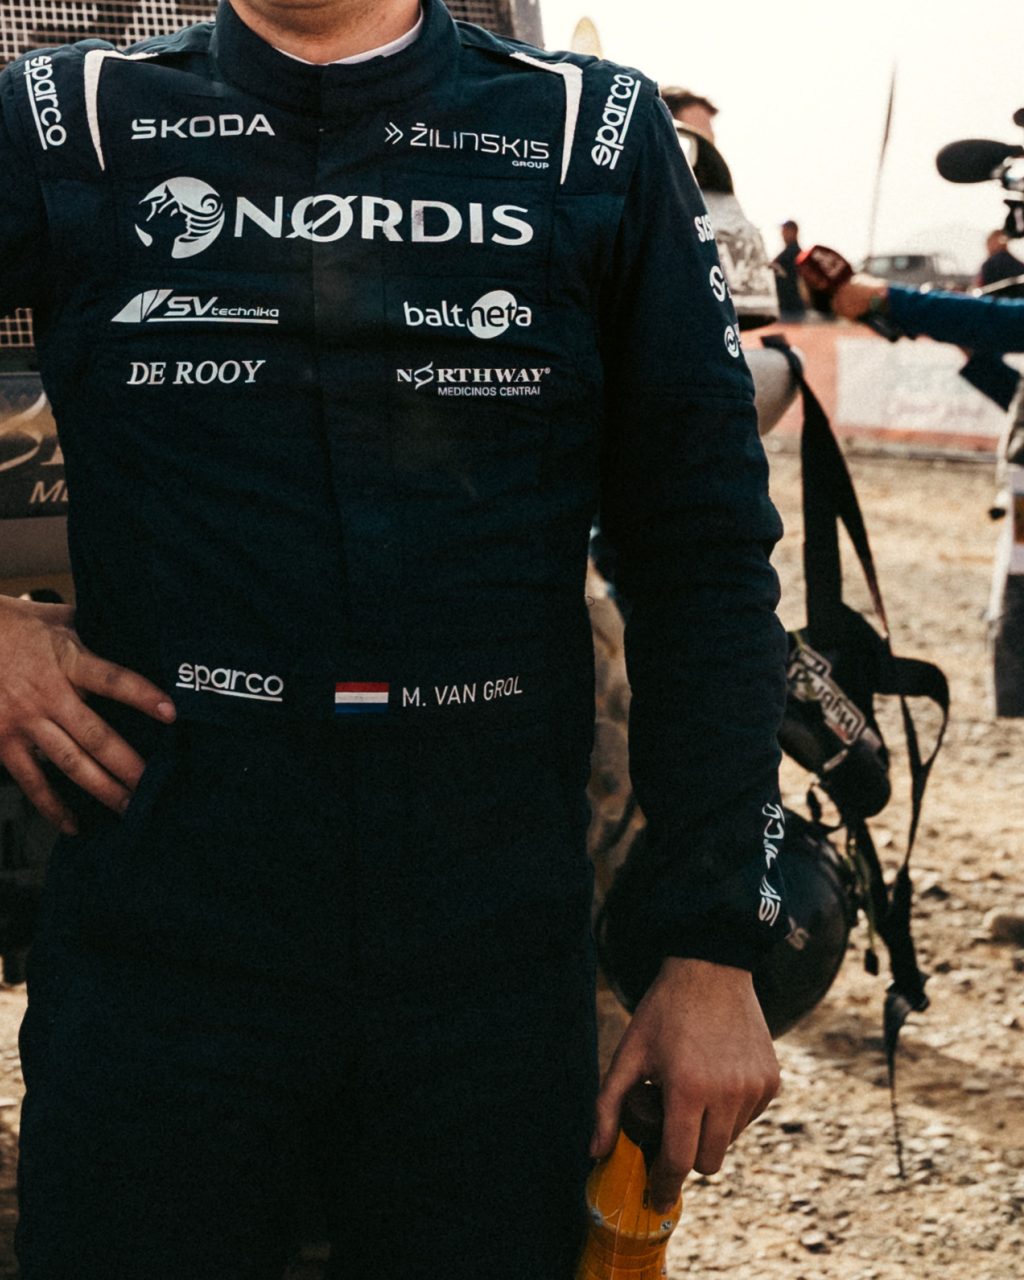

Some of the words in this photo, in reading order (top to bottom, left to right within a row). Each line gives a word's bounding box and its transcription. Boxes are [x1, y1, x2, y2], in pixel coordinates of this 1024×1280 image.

[24, 55, 67, 151] sparco
[591, 73, 642, 170] sparco
[511, 159, 550, 170] GROUP
[403, 299, 533, 328] baltneta
[126, 361, 167, 385] DE
[172, 359, 267, 384] ROOY
[437, 387, 498, 397] MEDICINOS
[175, 663, 284, 703] sparco
[401, 687, 427, 708] M.
[434, 683, 477, 706] VAN
[482, 675, 523, 701] GROL
